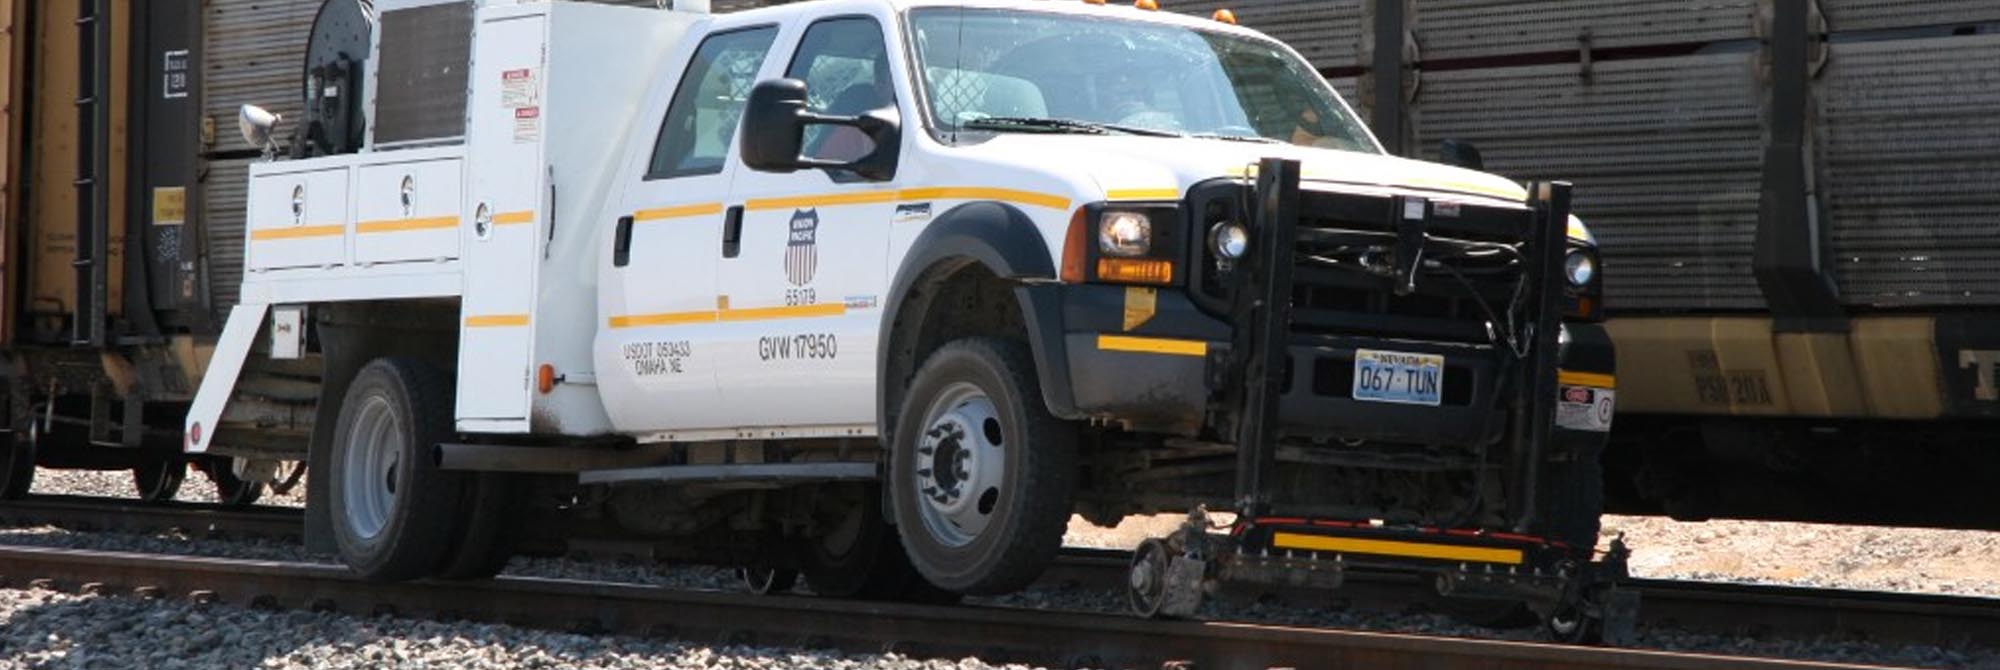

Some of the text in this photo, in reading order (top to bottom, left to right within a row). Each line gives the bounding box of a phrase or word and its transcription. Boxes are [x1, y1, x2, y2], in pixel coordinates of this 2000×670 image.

[793, 218, 815, 229] UNION
[790, 230, 814, 241] PACIFIC
[785, 288, 816, 306] 65179
[623, 341, 653, 359] USDOT
[759, 333, 837, 361] GVW 17950
[635, 357, 683, 376] OMAHA NE
[1361, 366, 1438, 395] 067 TUN
